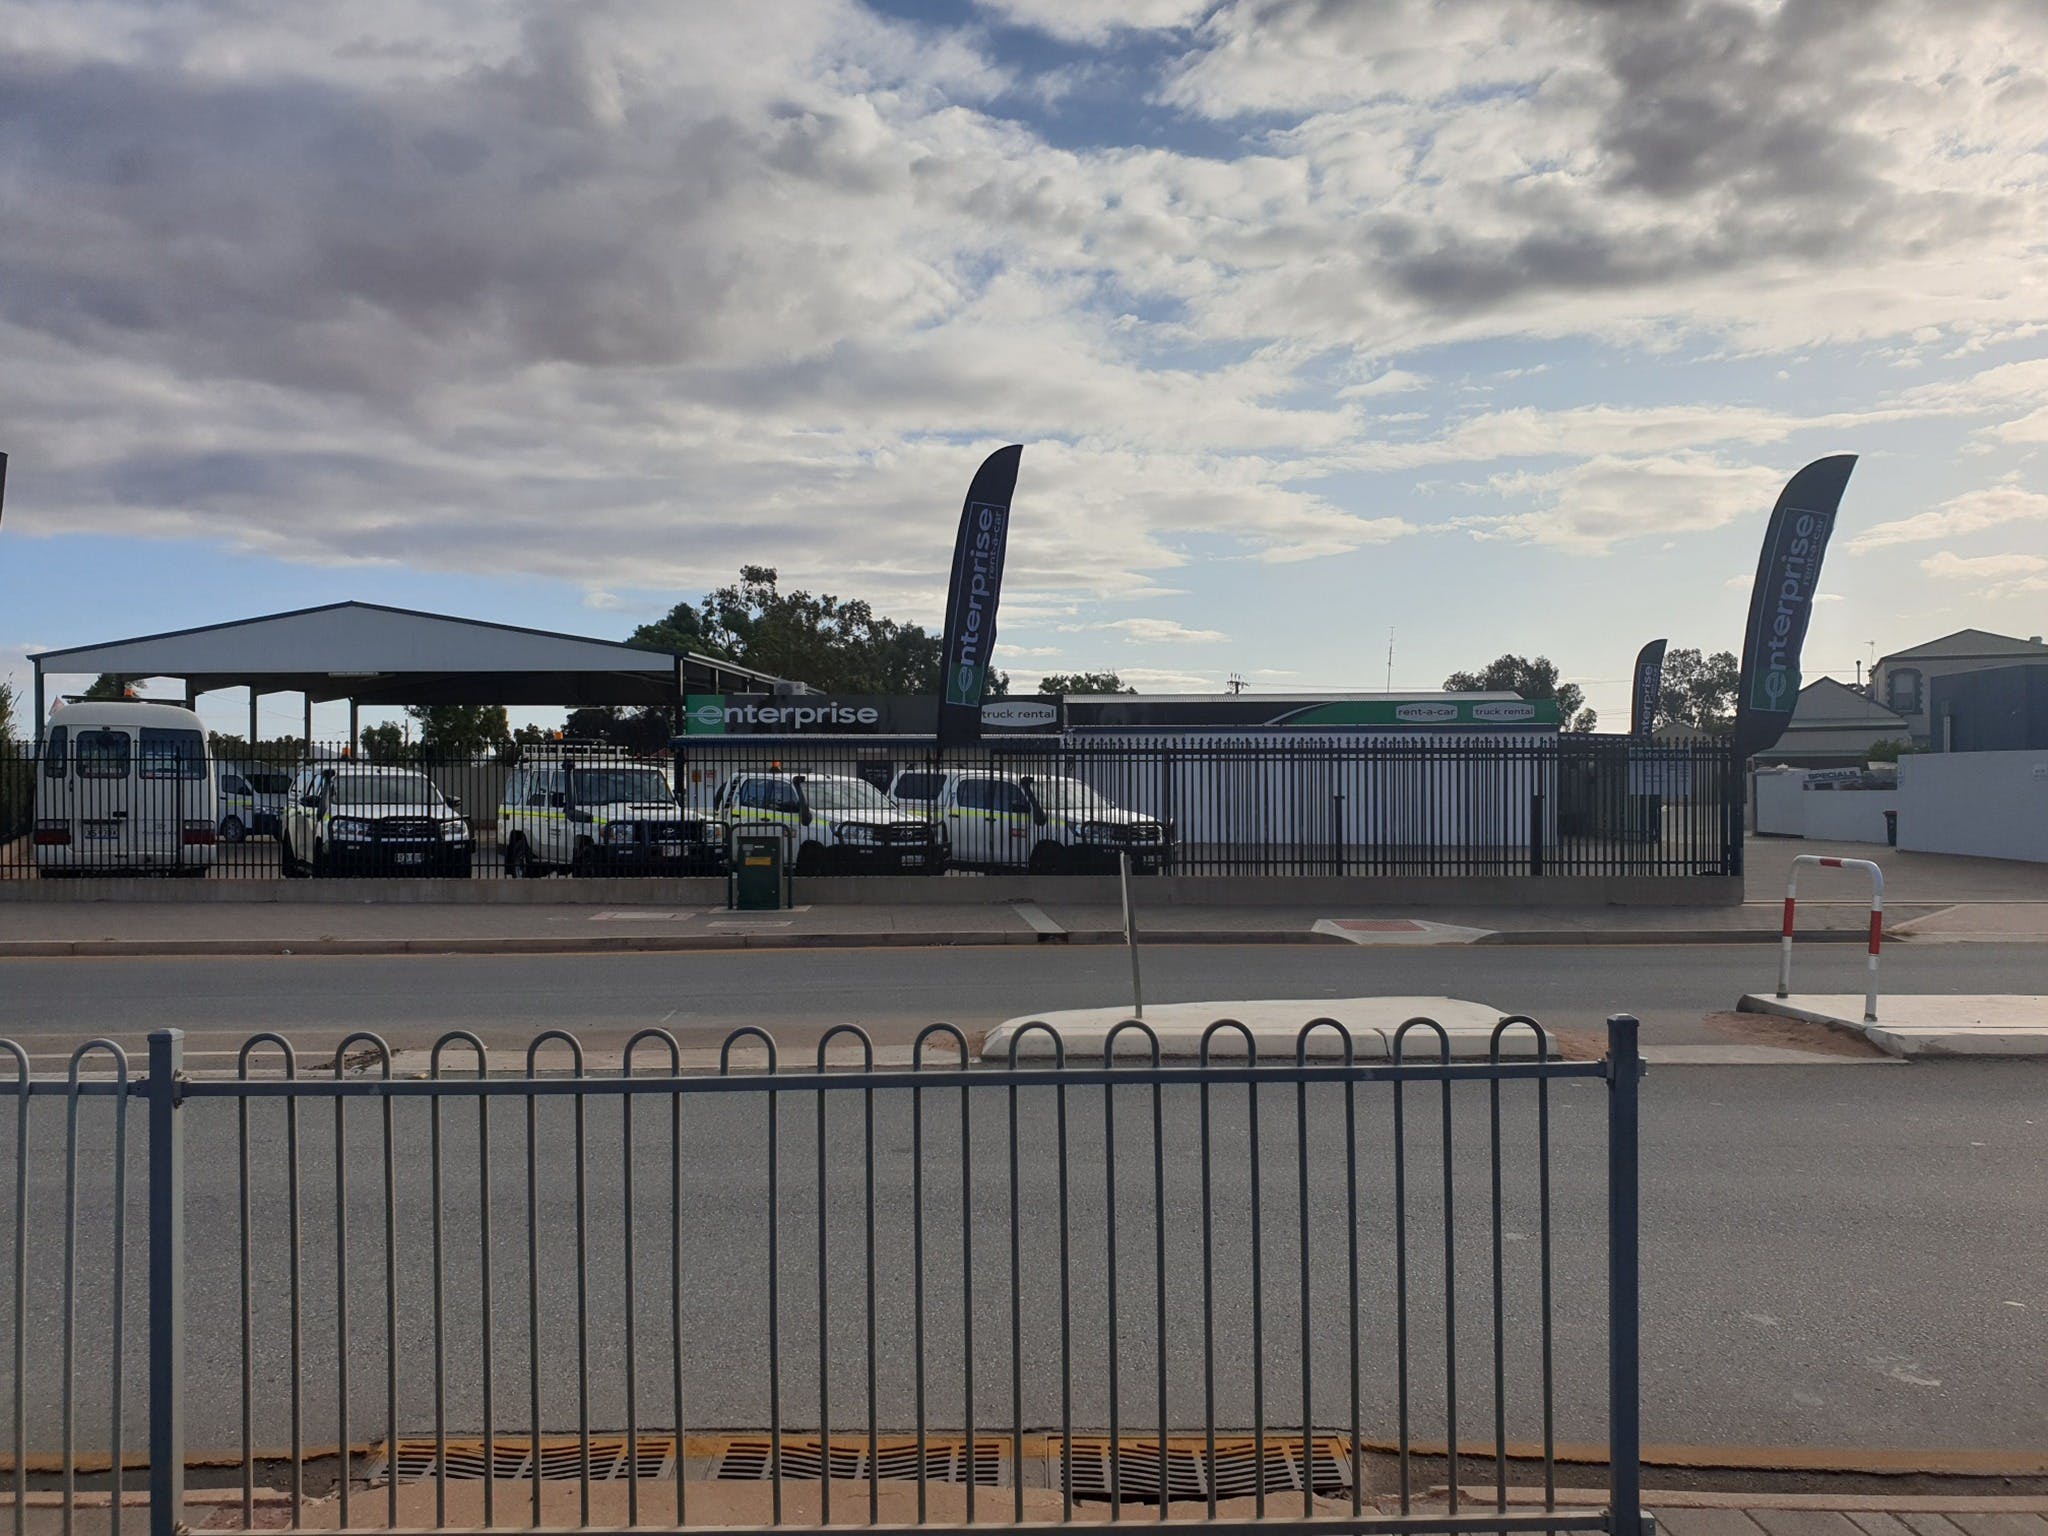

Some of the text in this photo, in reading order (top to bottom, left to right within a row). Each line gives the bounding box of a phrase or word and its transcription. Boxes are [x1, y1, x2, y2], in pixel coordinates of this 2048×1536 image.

[989, 512, 1001, 580] rent-a-car
[958, 508, 993, 693] enterprise
[1766, 514, 1814, 699] enterprise
[696, 702, 879, 729] enterprise
[982, 709, 1054, 719] truck rental
[1398, 708, 1455, 716] rent-a-car
[1475, 707, 1534, 716] truck rental
[1642, 665, 1653, 735] nterprise
